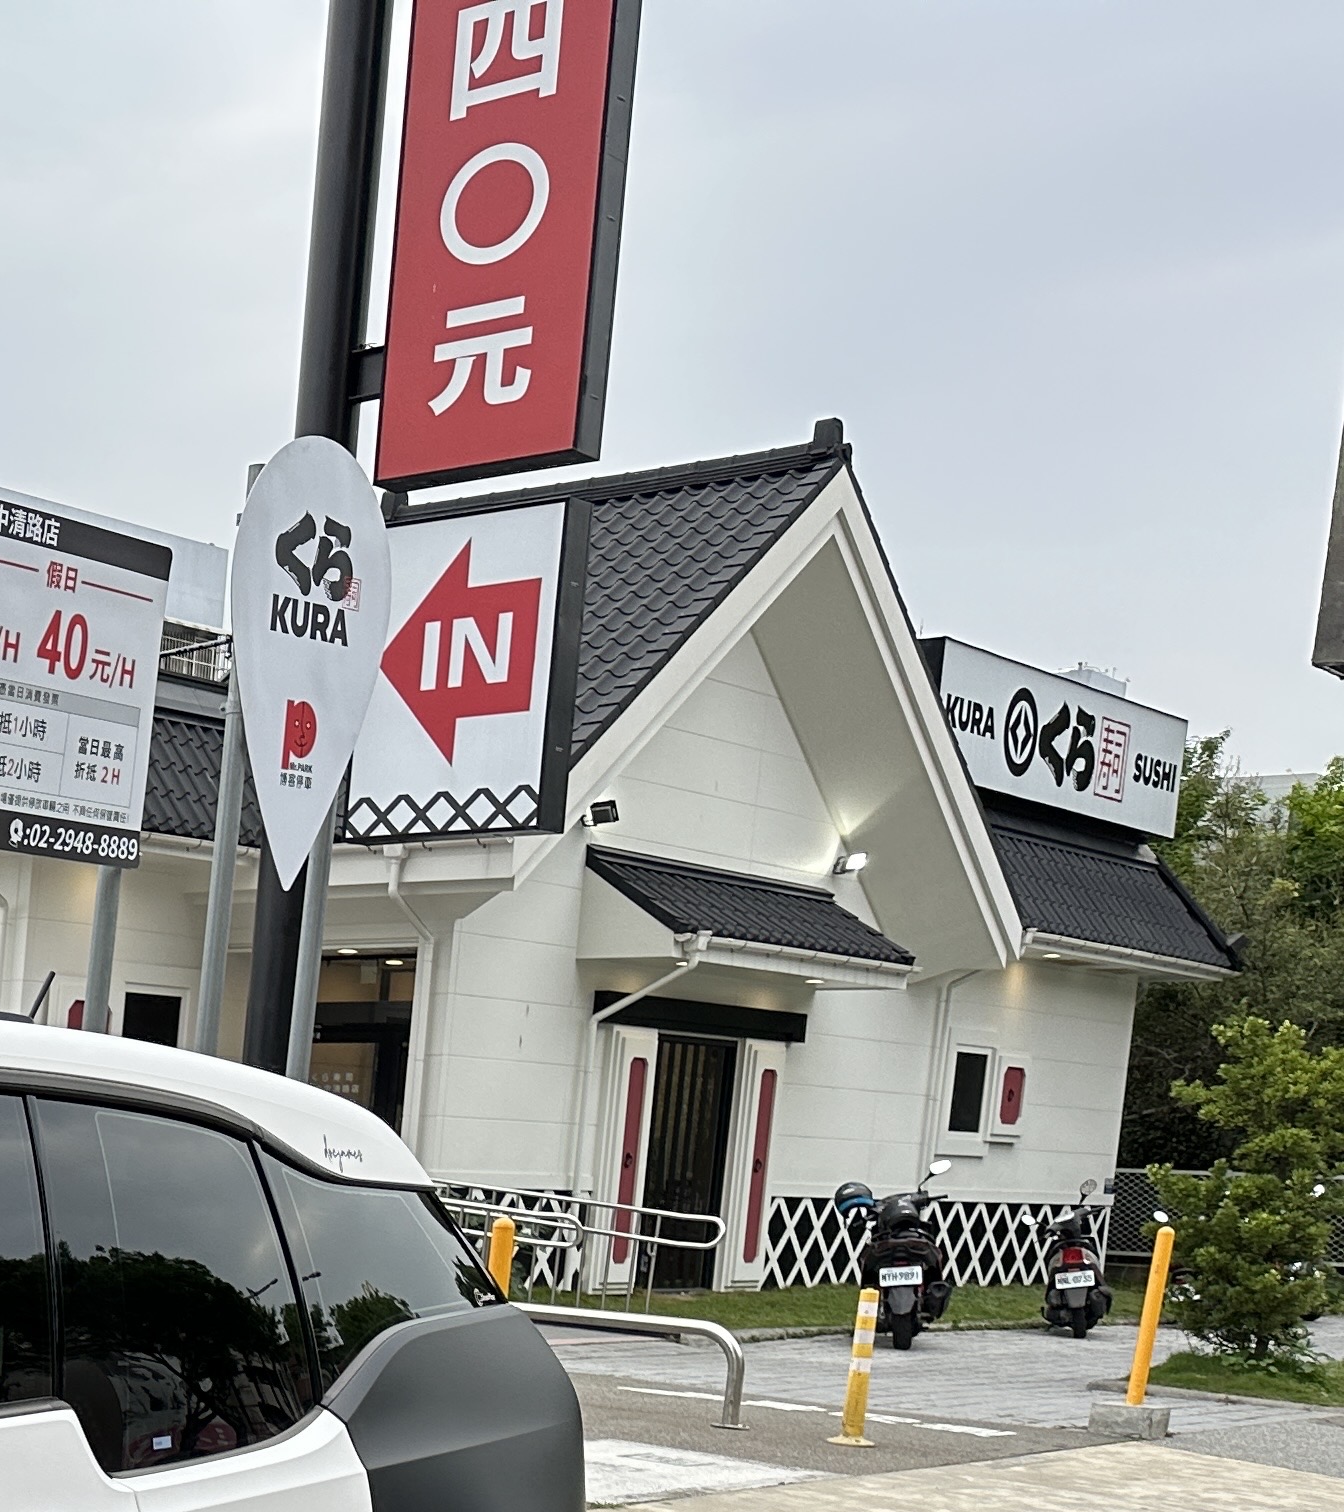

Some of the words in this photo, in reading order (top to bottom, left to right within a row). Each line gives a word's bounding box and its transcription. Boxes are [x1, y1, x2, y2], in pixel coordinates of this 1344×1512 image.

[46, 561, 79, 593] 假日
[269, 593, 348, 647] KURA
[419, 611, 514, 692] IN
[946, 693, 995, 740] KURA
[77, 735, 125, 762] 當日最高
[1132, 752, 1178, 793] SUSHI
